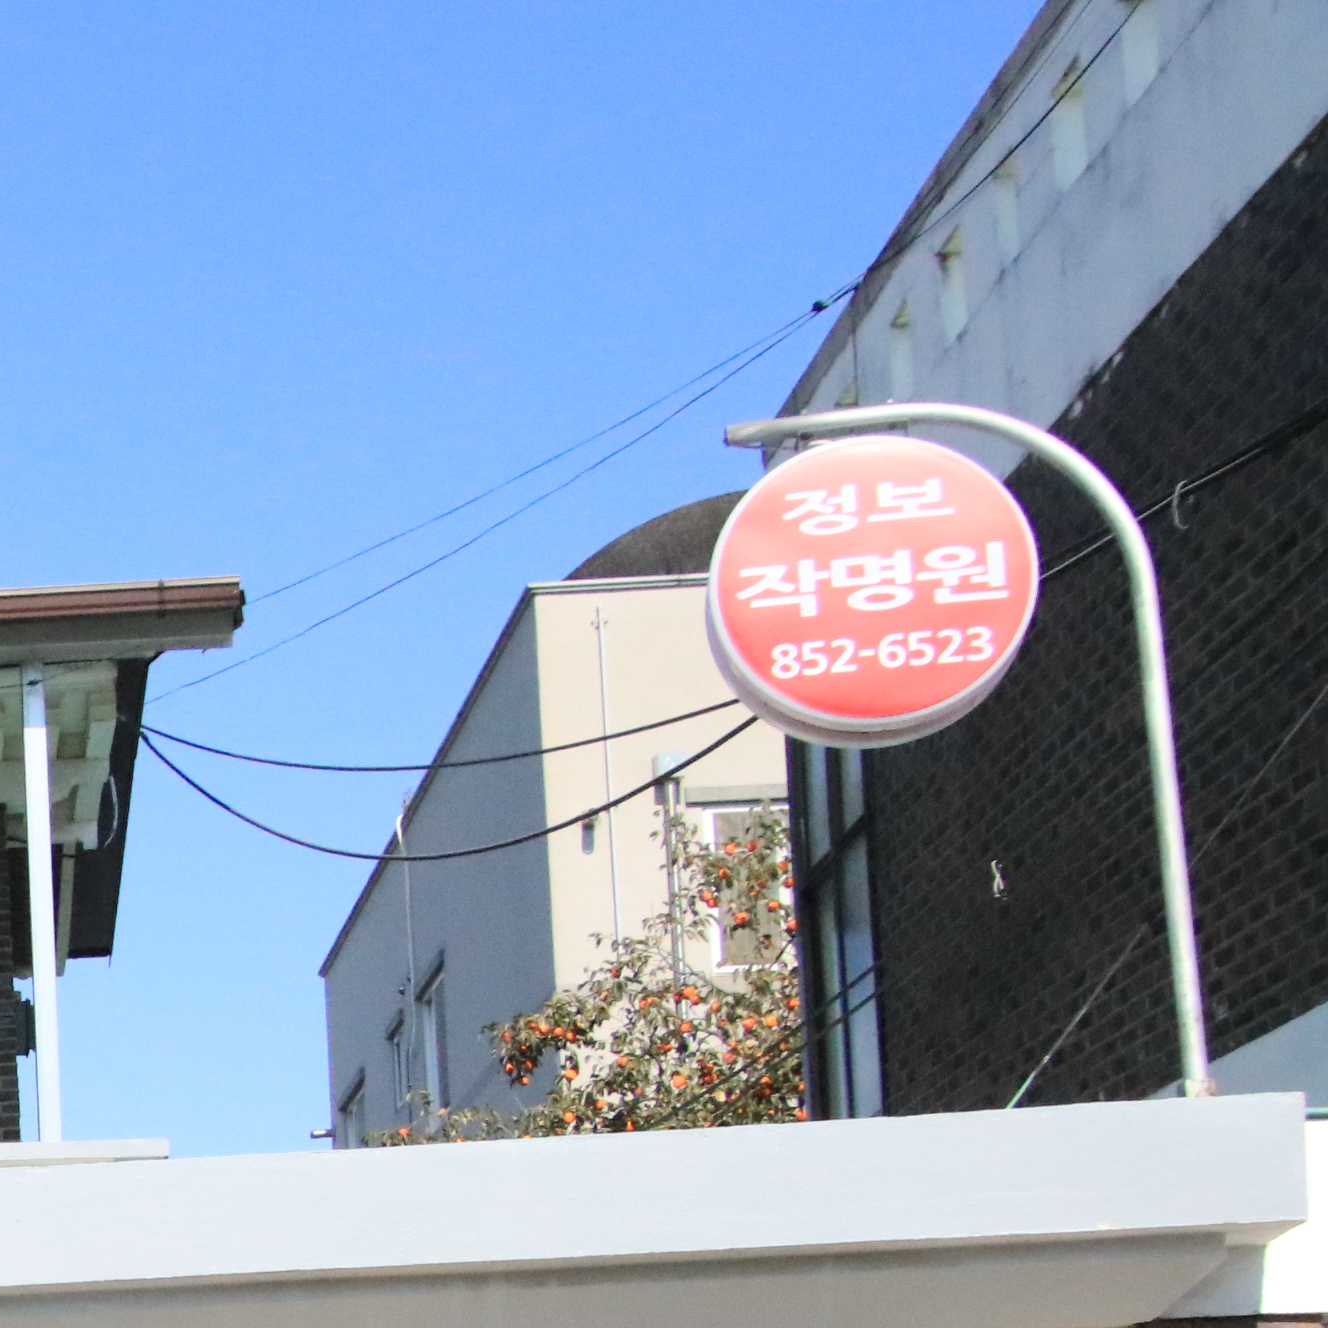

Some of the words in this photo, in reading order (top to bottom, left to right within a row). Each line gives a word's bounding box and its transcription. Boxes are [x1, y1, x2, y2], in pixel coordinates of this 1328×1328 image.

[781, 476, 956, 536] 정보
[735, 540, 1010, 618] 작명원
[770, 625, 995, 679] 852-6523
